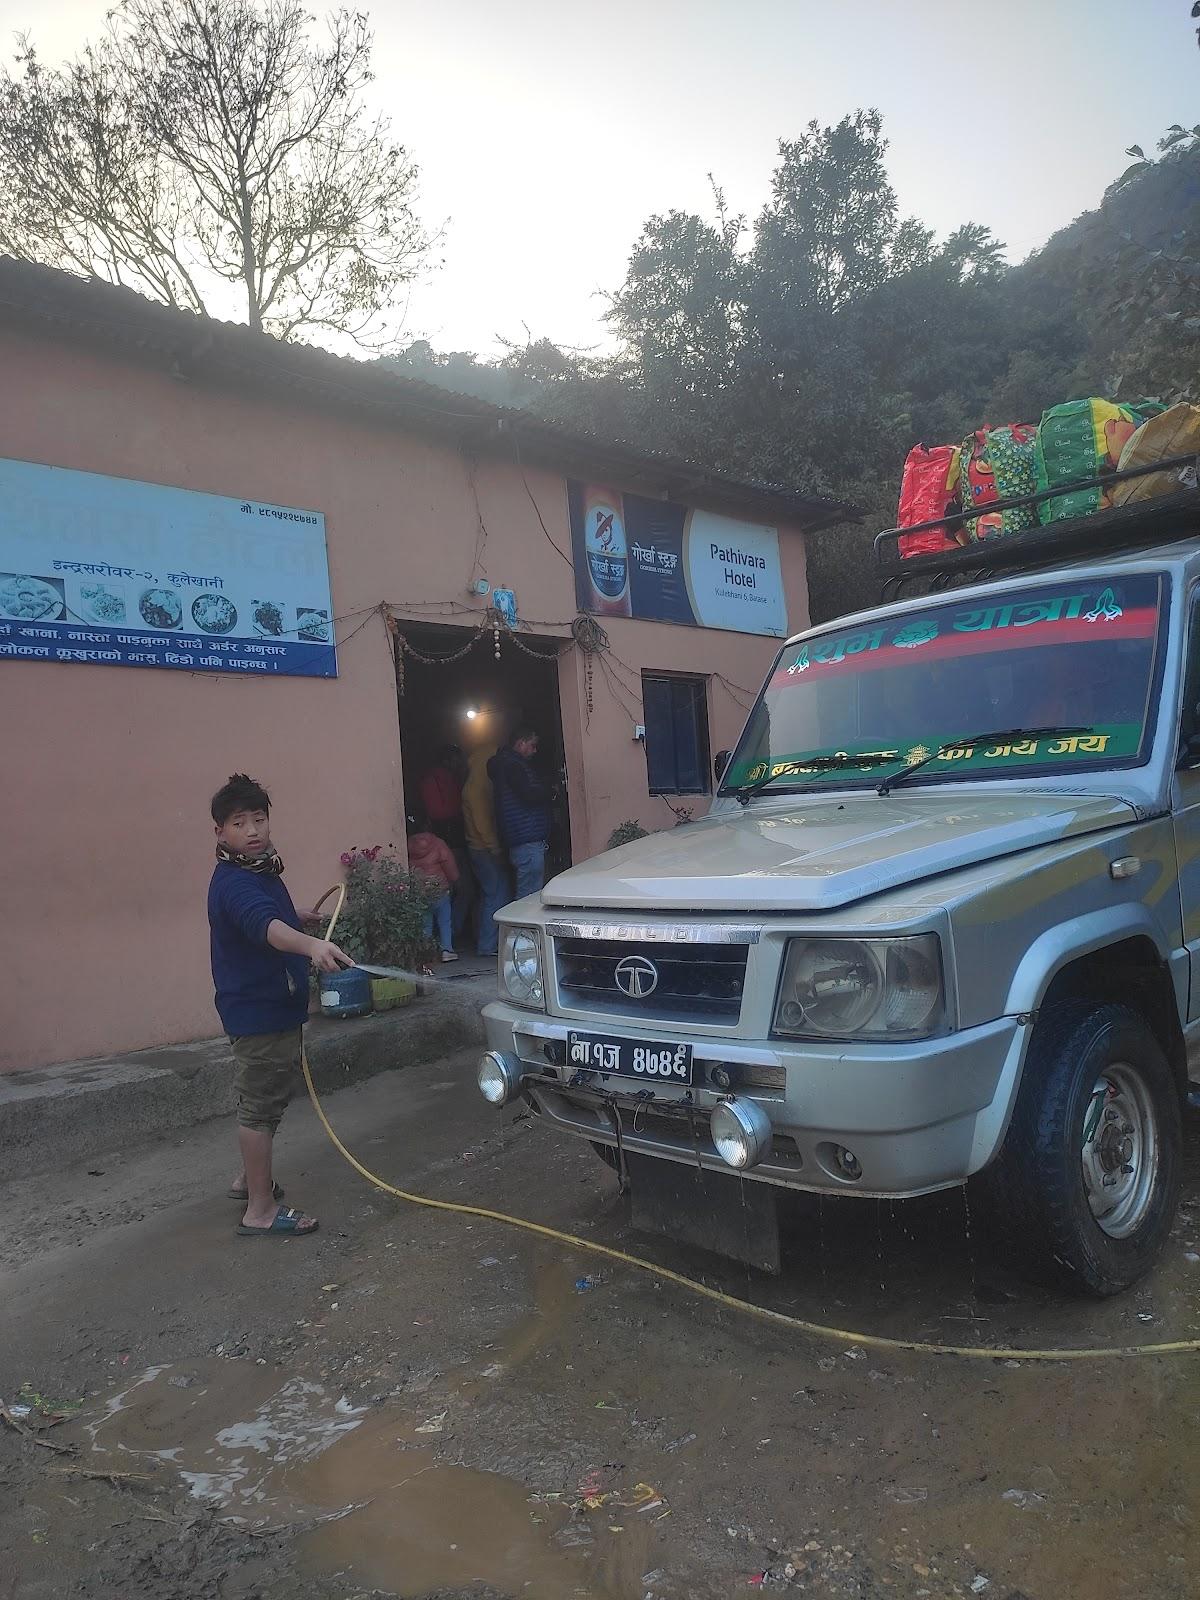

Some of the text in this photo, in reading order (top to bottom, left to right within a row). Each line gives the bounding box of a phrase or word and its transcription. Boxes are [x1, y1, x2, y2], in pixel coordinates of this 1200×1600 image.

[240, 503, 318, 525] मो. ९८१५२२९७४४
[631, 542, 655, 564] गोर्खा
[710, 543, 766, 569] Pathivara
[53, 559, 225, 589] इन्द्रसरोवर-२, कुलेखानी
[724, 567, 756, 588] Hotel
[813, 594, 1089, 664] शुभ यात्रा
[244, 644, 287, 656] अनुसार
[199, 655, 223, 667] पनि
[228, 658, 268, 670] पाइन्छ
[1047, 735, 1111, 755] जय
